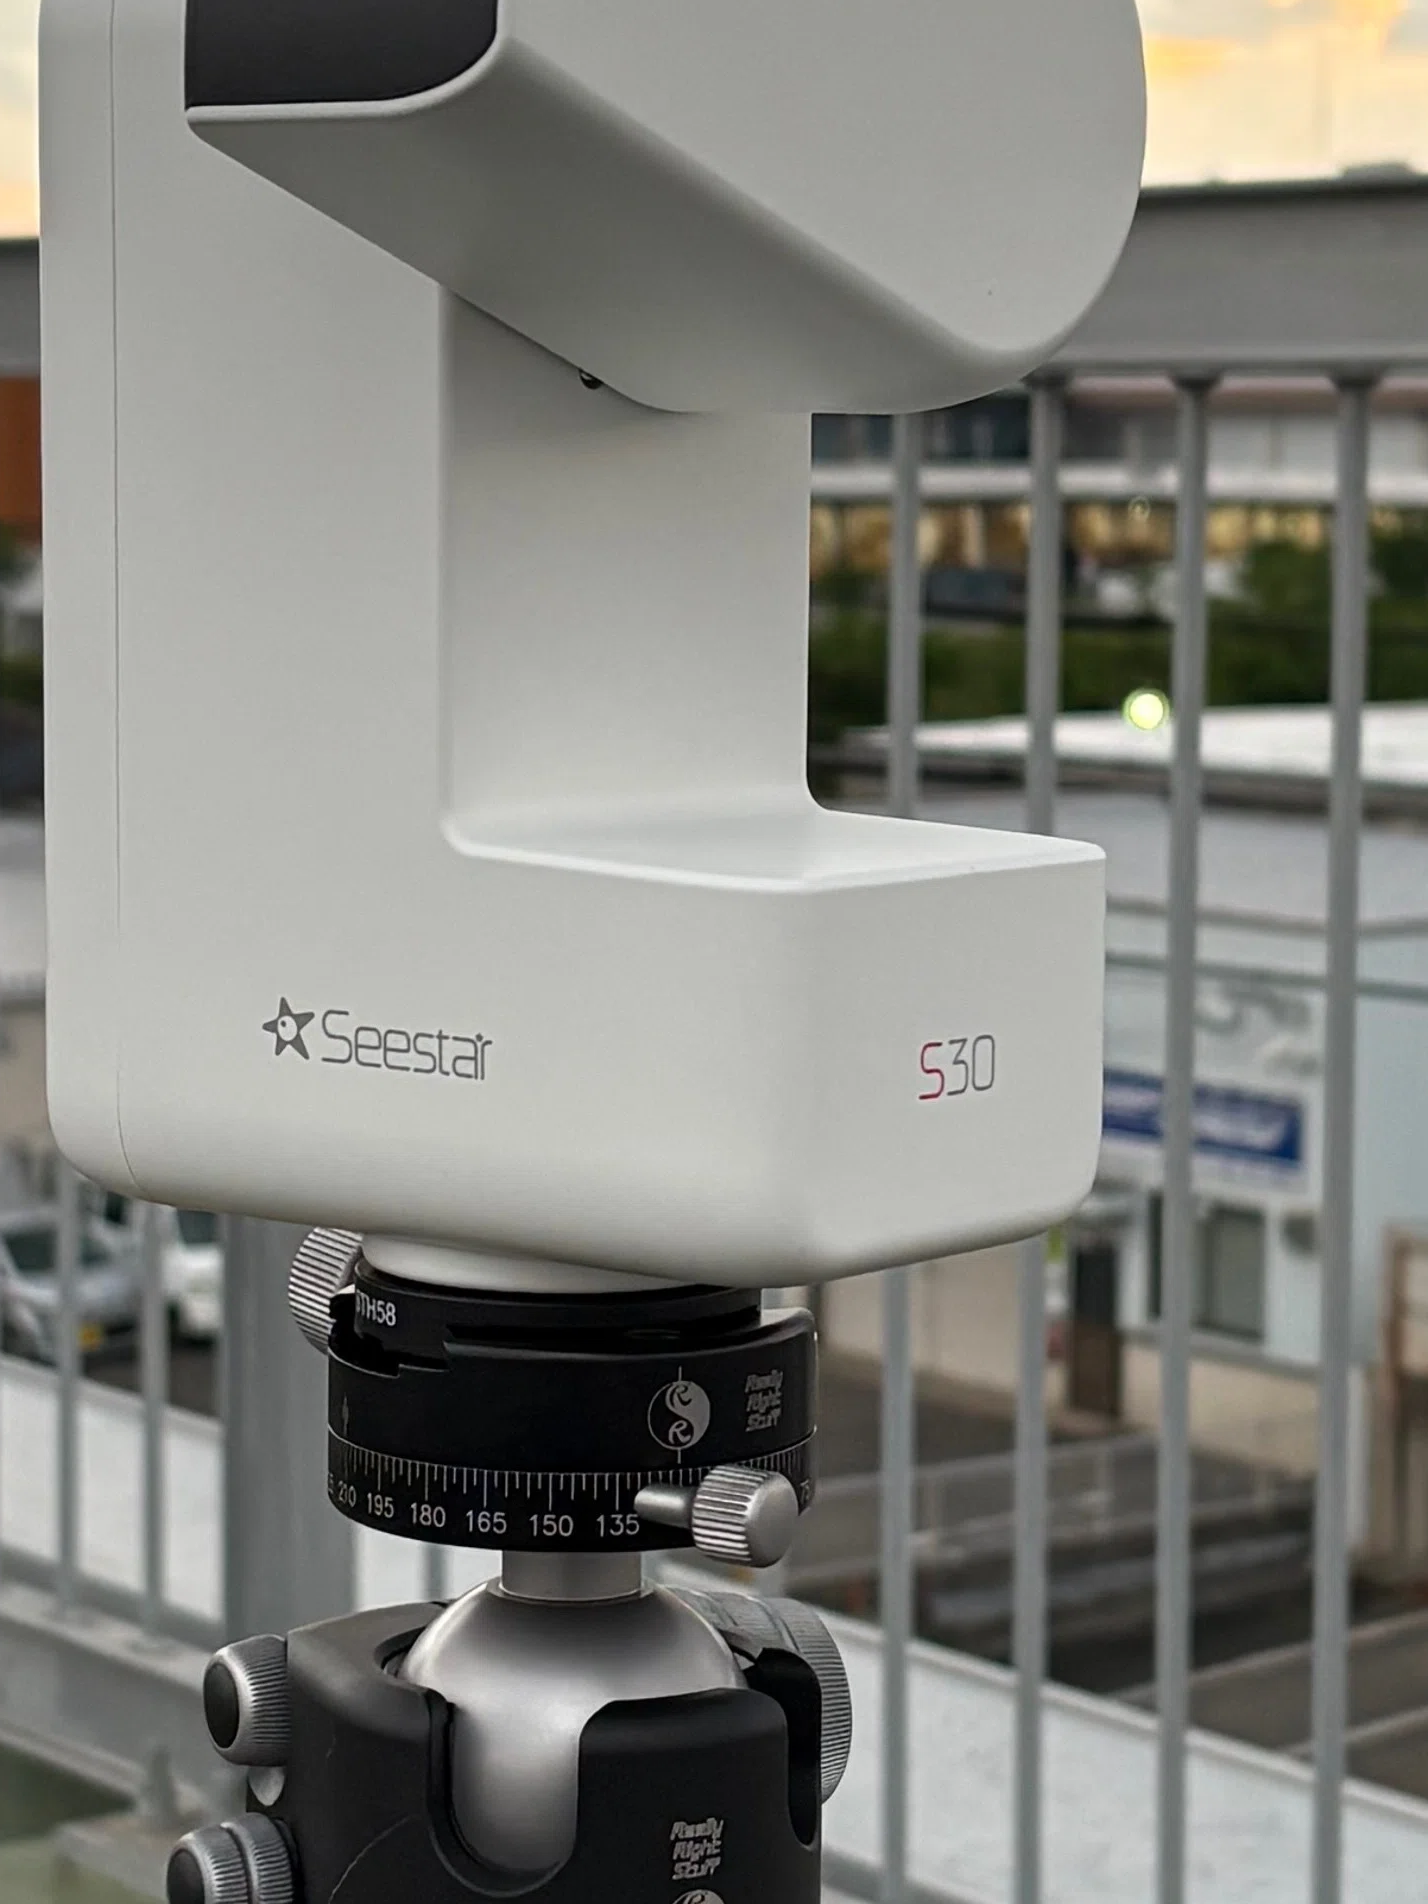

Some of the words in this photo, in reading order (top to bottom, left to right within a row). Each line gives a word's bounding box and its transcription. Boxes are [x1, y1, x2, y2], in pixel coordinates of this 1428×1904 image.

[322, 1009, 493, 1080] Seestar
[918, 1034, 995, 1100] S30
[367, 1492, 395, 1519] 195
[410, 1501, 446, 1528] 180
[465, 1509, 508, 1535] 165
[529, 1513, 574, 1538] 150
[596, 1513, 640, 1538] 135
